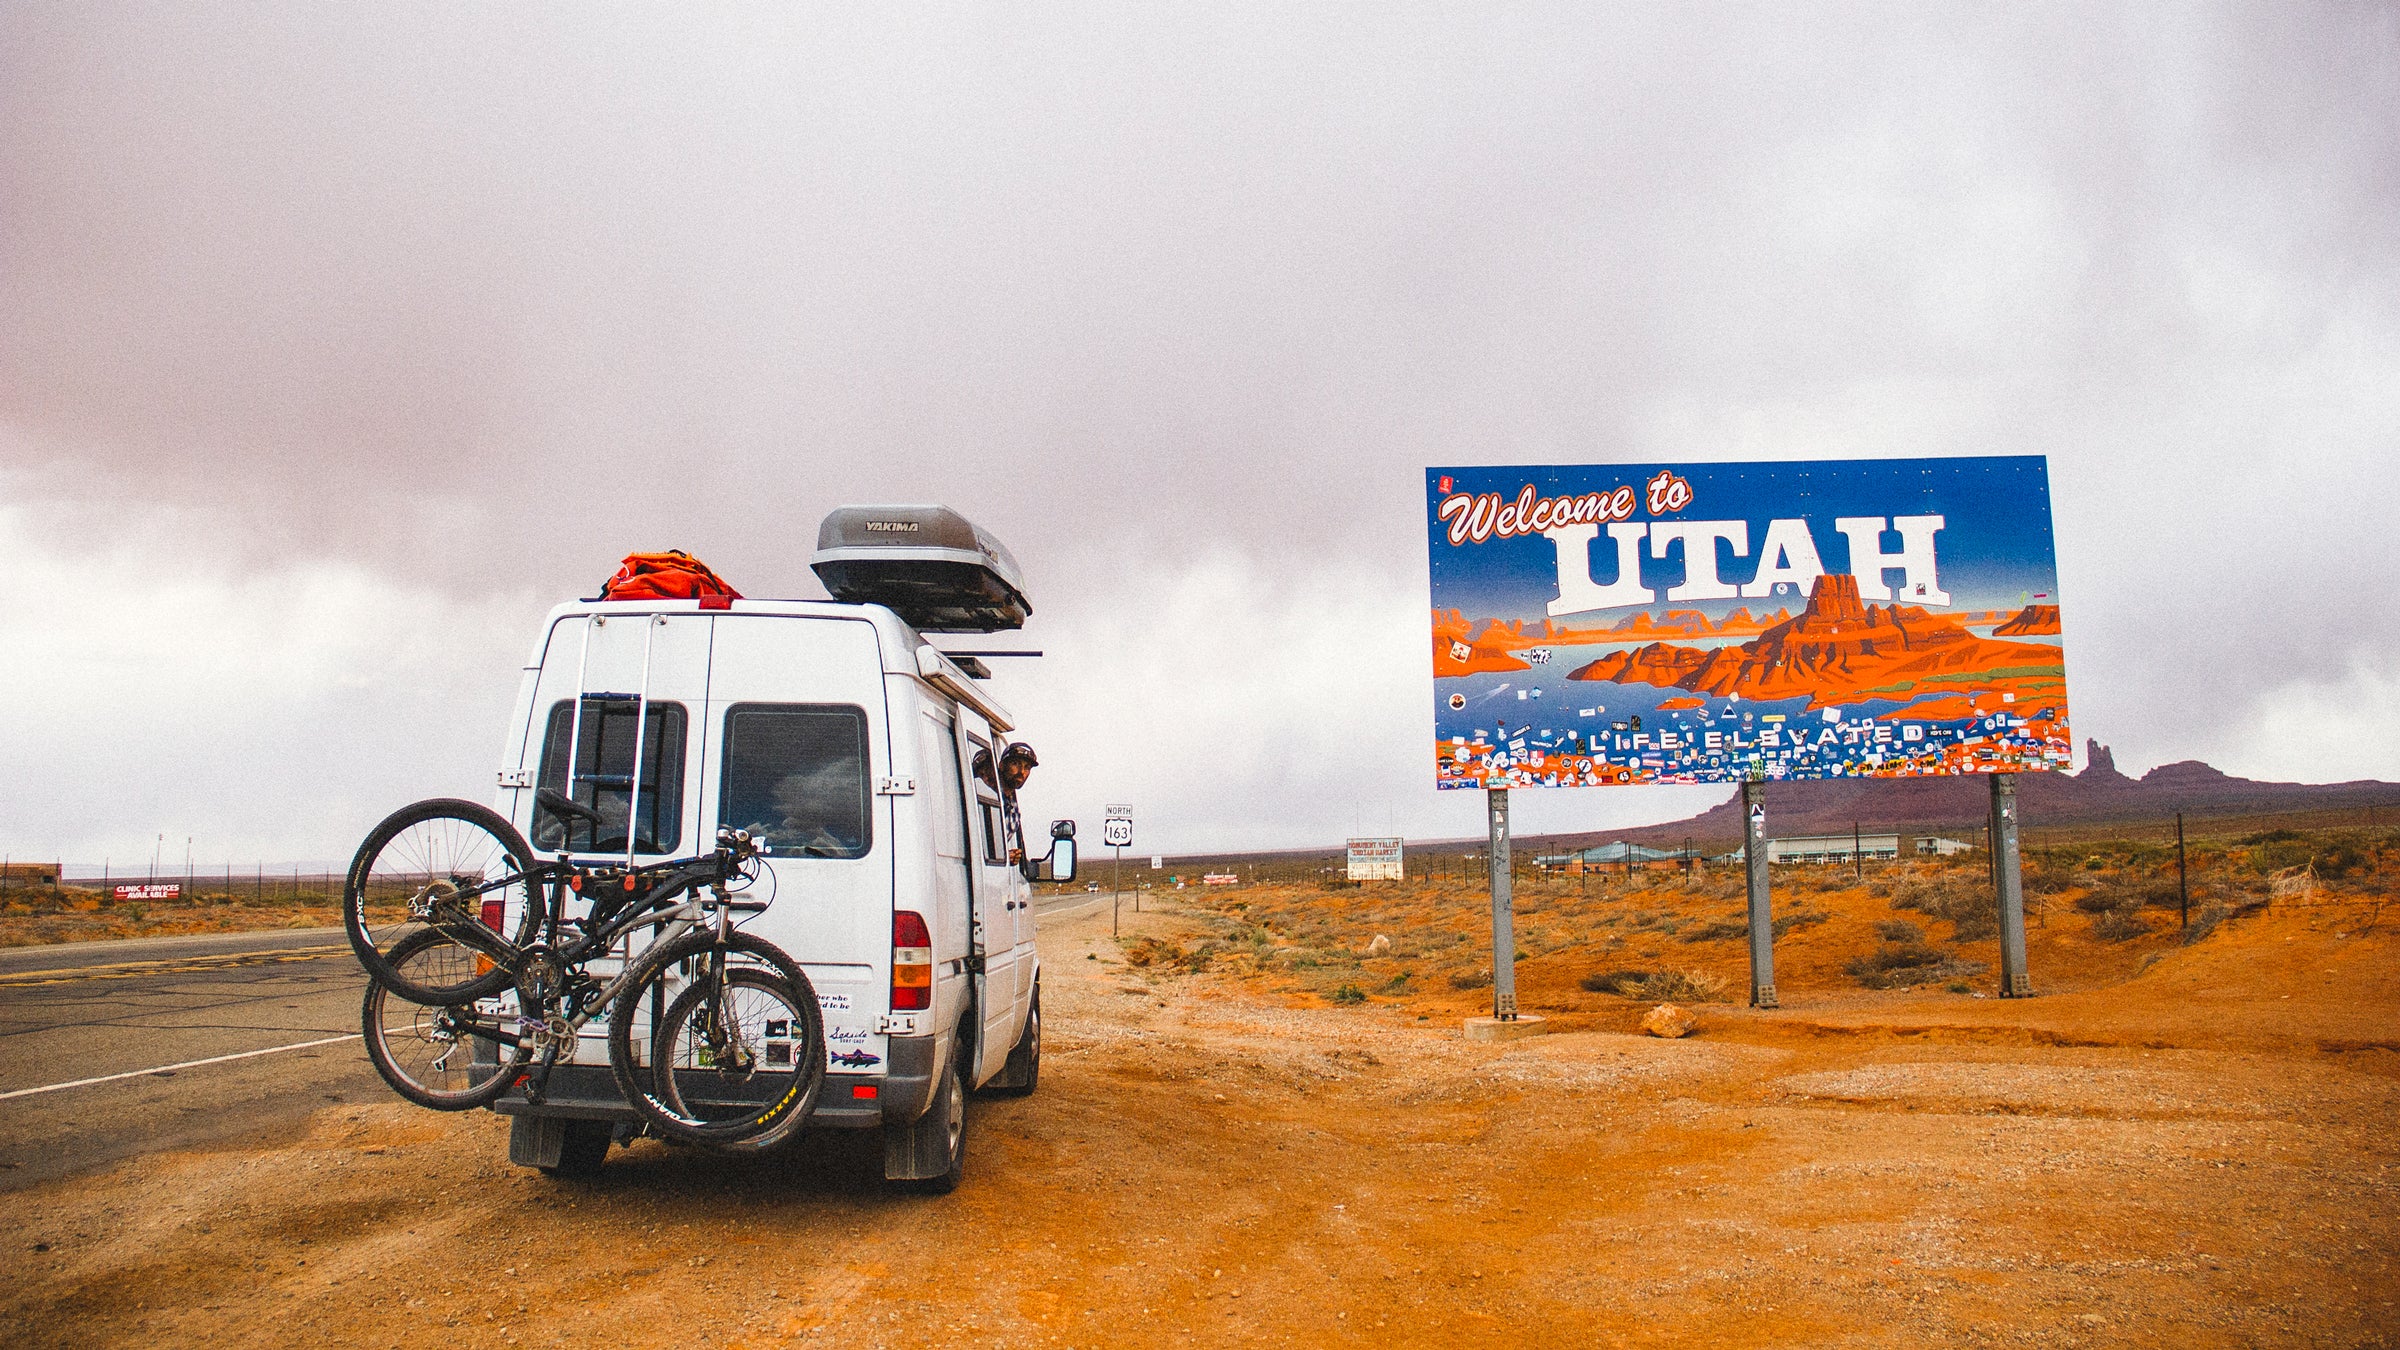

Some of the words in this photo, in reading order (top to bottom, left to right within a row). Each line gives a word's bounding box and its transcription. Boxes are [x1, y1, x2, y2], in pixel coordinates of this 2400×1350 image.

[1438, 484, 1636, 546] Welcome
[1646, 470, 1694, 516] to
[866, 521, 919, 532] YAKIMA
[1544, 515, 1951, 617] UTAH
[1590, 732, 1678, 752] LIFE
[1704, 724, 1924, 749] ELEVATED
[1107, 806, 1131, 815] NORTH
[1109, 826, 1128, 839] 163
[116, 885, 142, 893] CLINIC
[144, 884, 180, 892] SERVICES
[127, 891, 168, 899] AVAILABLE
[839, 1002, 850, 1010] be
[643, 1092, 682, 1121] GIANT
[757, 1086, 797, 1125] MAXXIS
